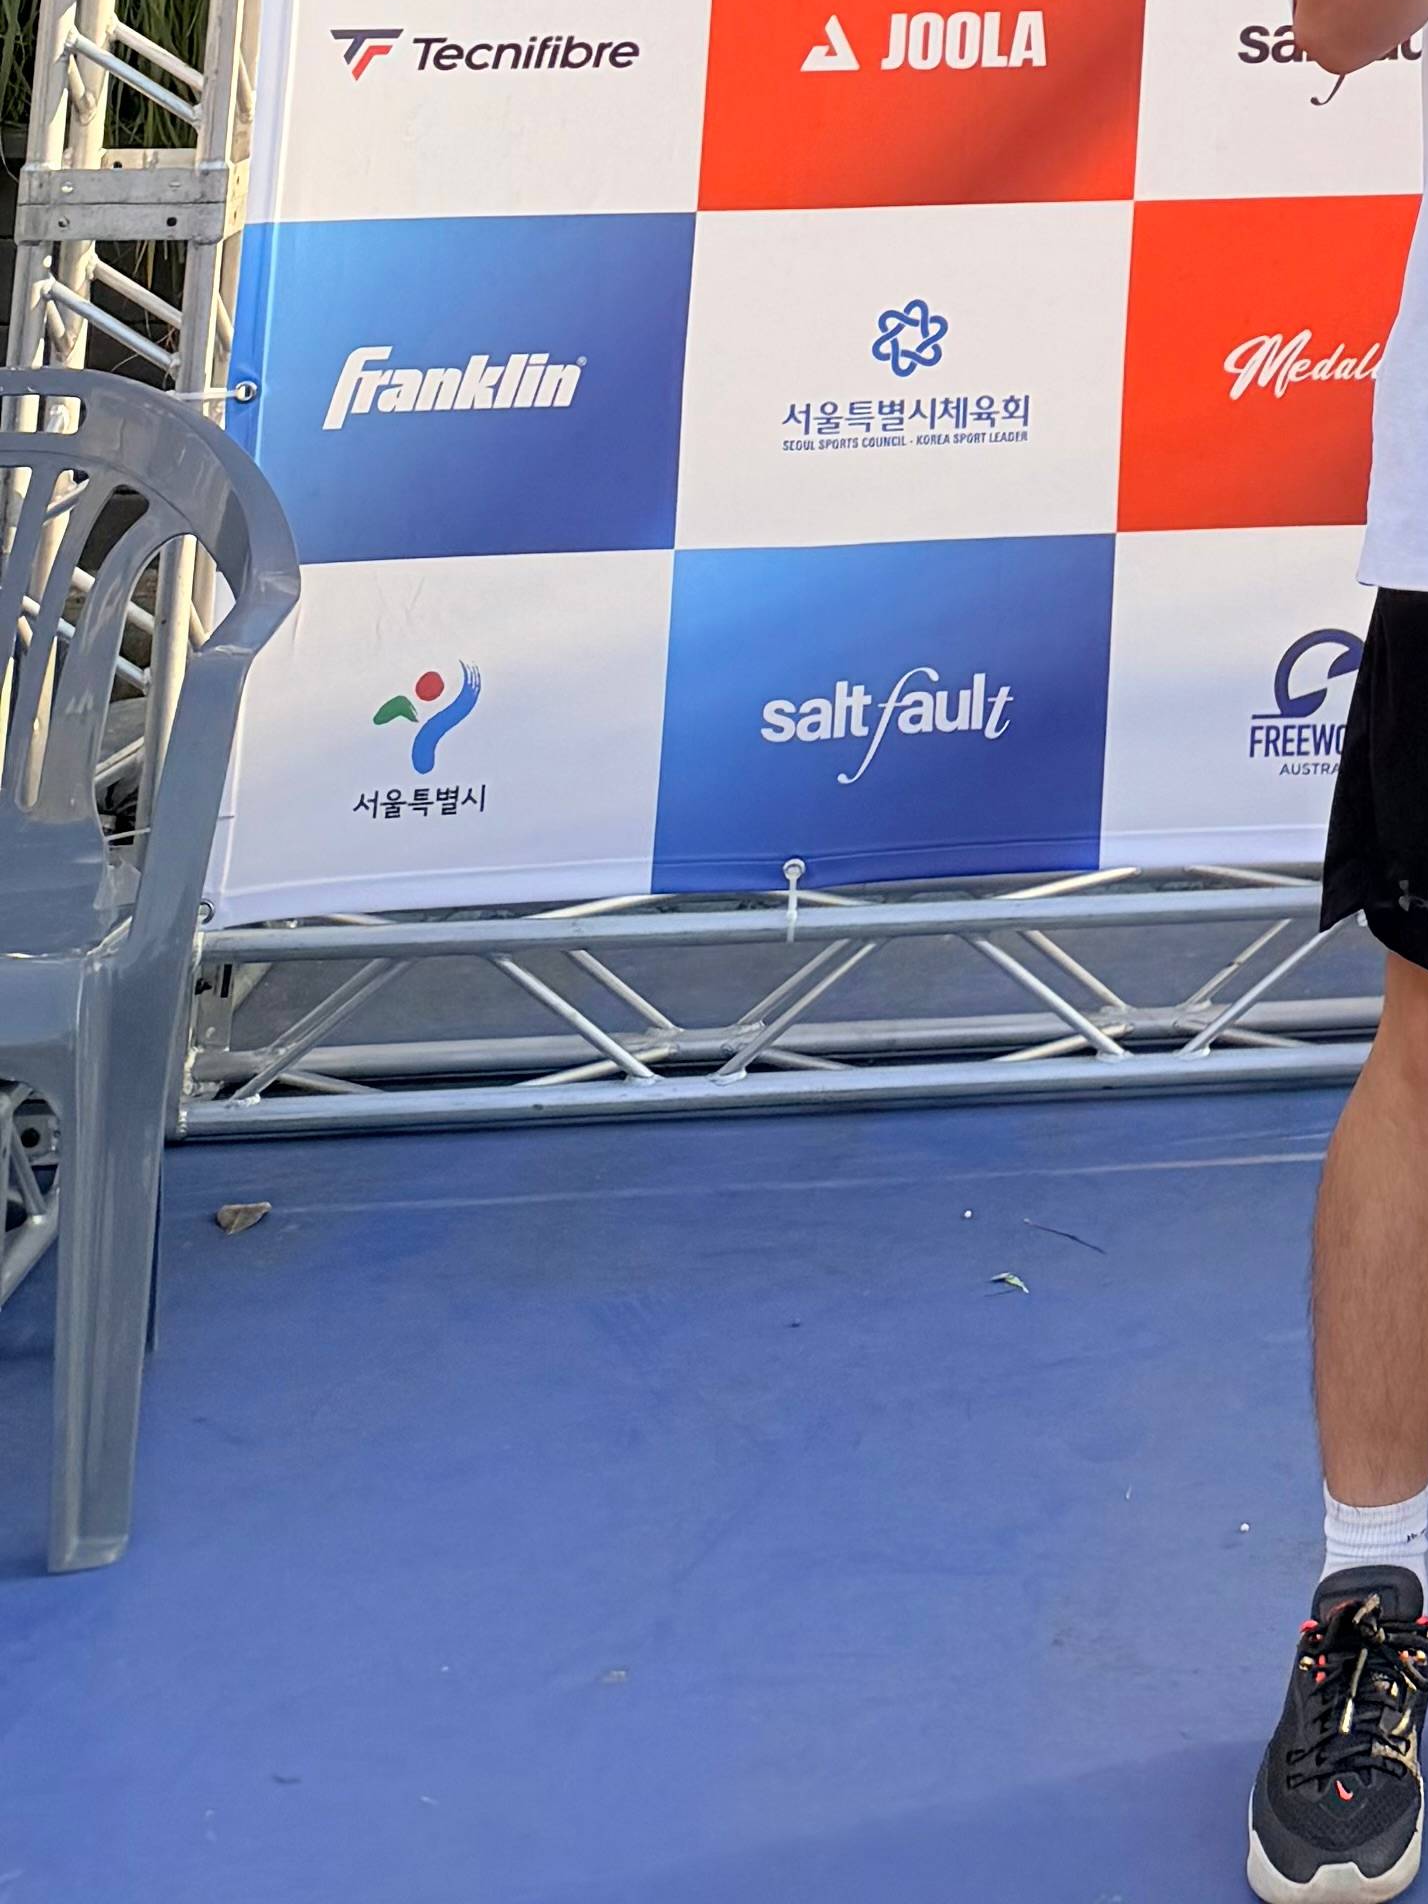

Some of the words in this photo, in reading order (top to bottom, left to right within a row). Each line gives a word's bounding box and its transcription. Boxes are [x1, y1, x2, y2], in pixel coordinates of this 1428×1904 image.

[412, 36, 641, 73] Tecnifibre
[882, 11, 1048, 70] JOOLA
[323, 345, 588, 431] franklin
[781, 395, 1031, 438] 서울특별시체육회
[782, 439, 817, 452] SEOUL
[819, 438, 859, 451] SPORTS
[862, 436, 907, 449] COUNCIL
[916, 434, 951, 447] KOREA
[953, 433, 986, 445] SPORT
[989, 431, 1029, 444] LEADER
[353, 784, 487, 820] 서울특별시
